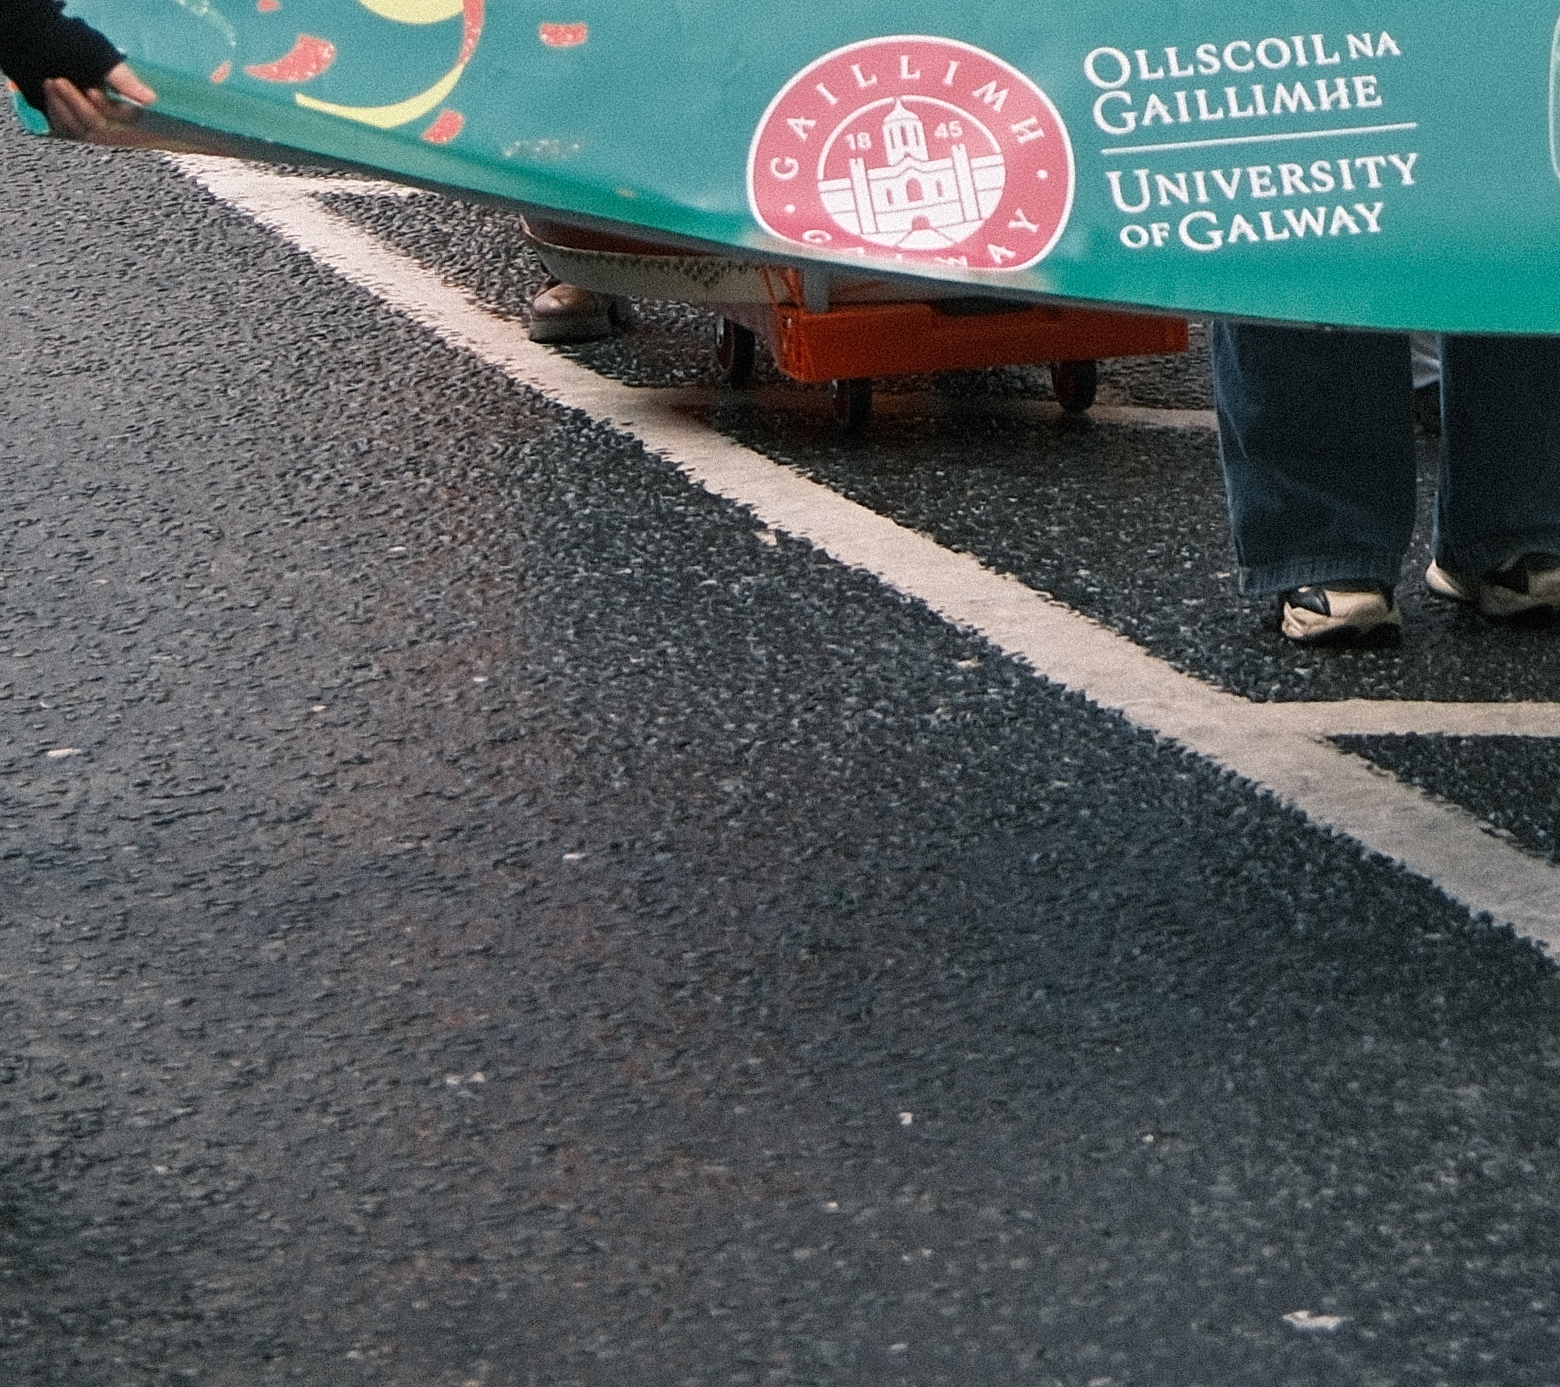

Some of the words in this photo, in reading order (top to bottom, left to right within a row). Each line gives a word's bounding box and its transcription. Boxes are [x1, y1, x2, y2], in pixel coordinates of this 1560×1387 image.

[1083, 33, 1341, 90] OLLSCOIL
[1346, 30, 1401, 60] NA
[845, 130, 872, 151] 18
[934, 119, 964, 139] 45
[1092, 74, 1383, 136] GAILLIMHE
[1104, 152, 1418, 214] UNIVERSITY
[1178, 201, 1384, 252] GALWAY
